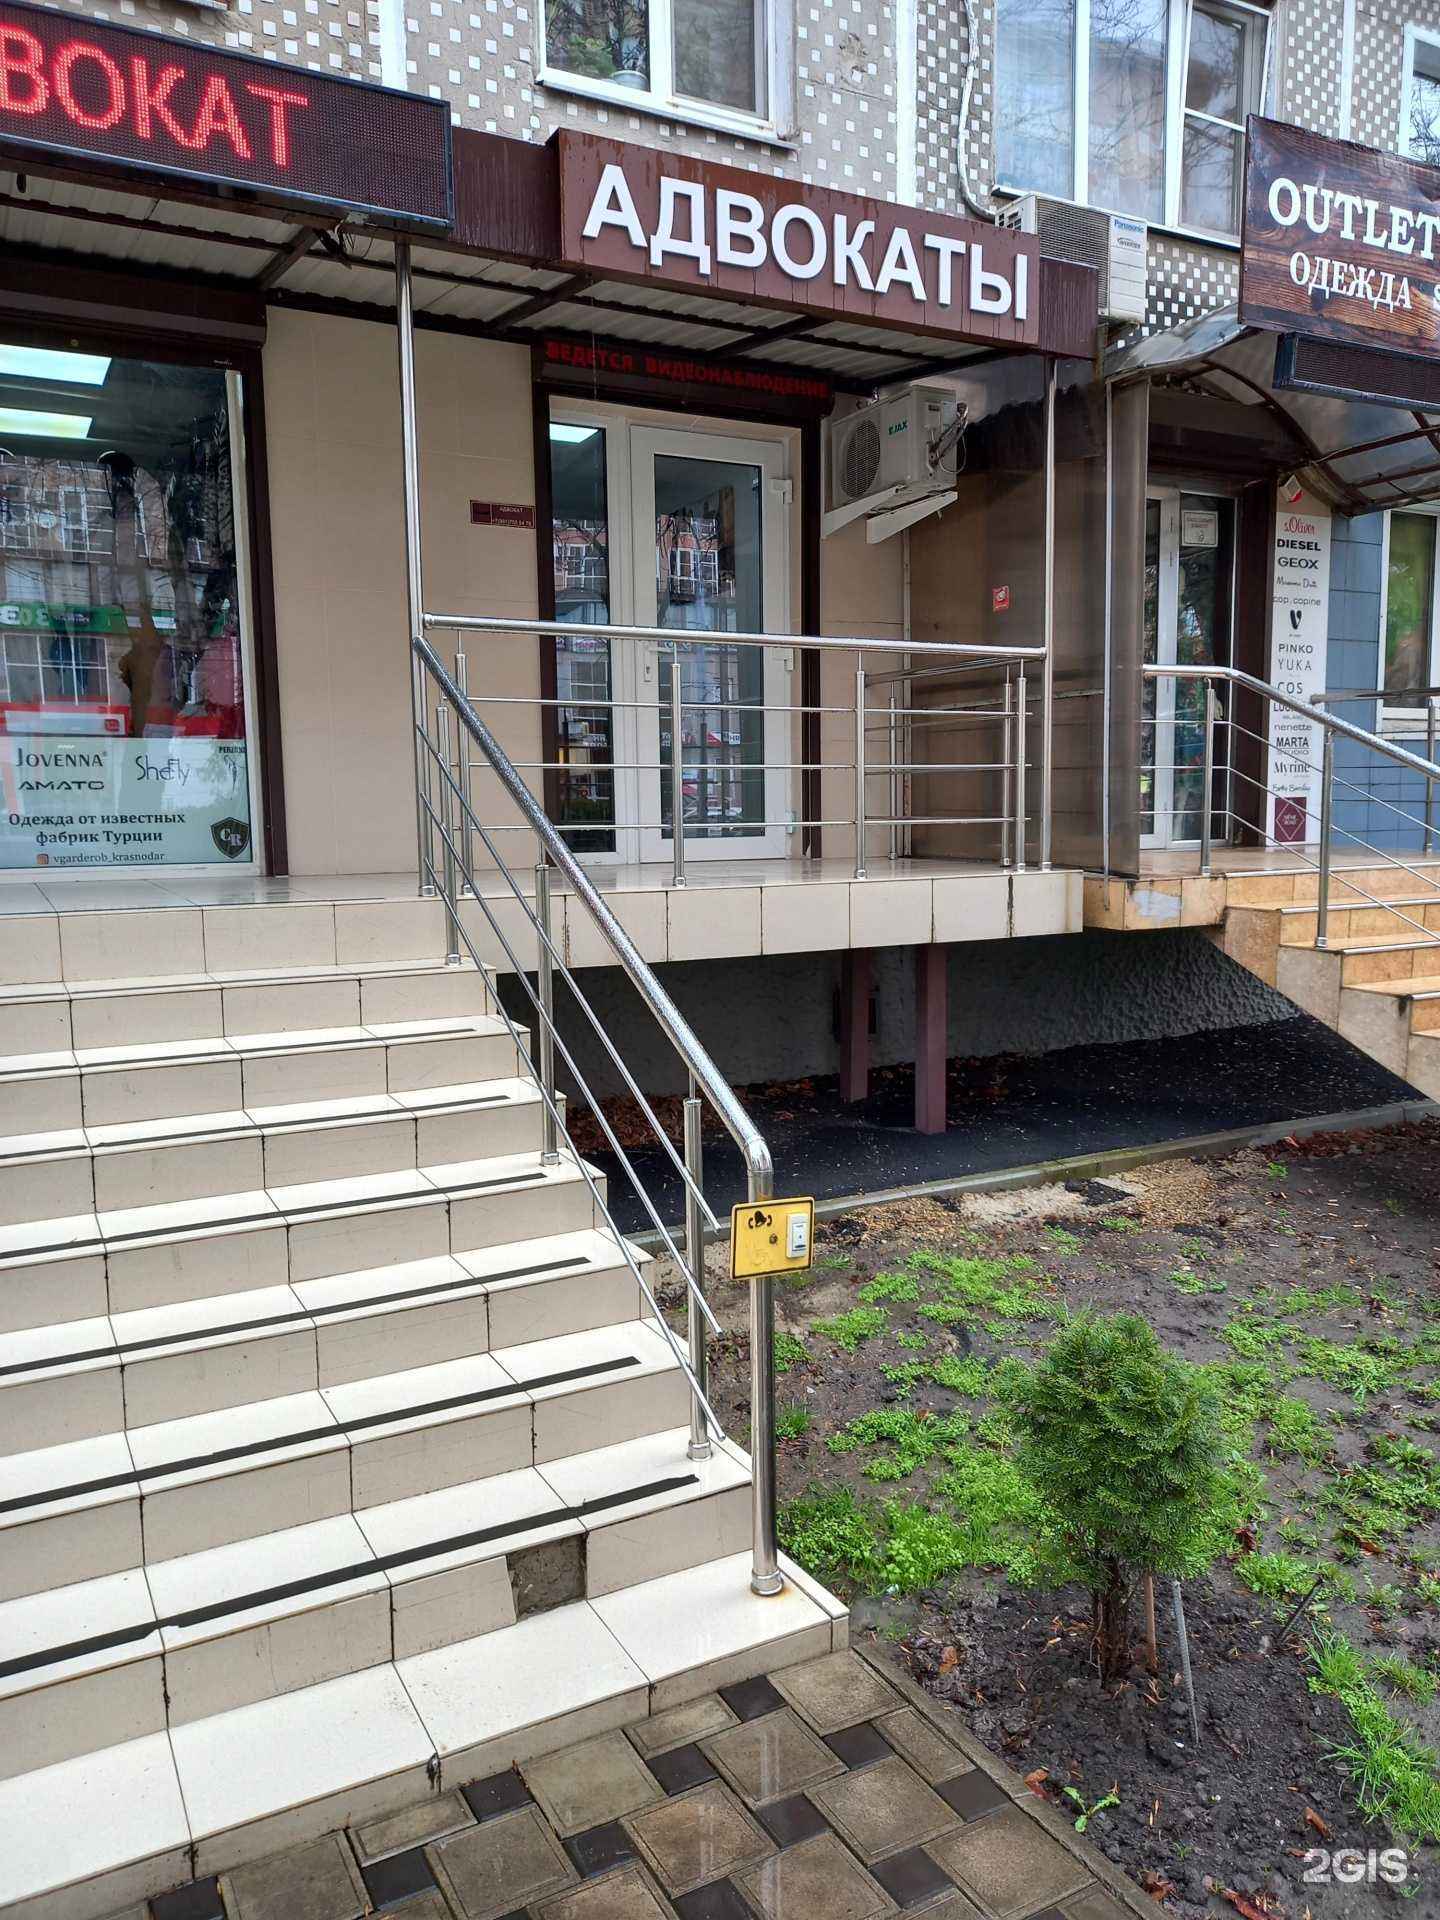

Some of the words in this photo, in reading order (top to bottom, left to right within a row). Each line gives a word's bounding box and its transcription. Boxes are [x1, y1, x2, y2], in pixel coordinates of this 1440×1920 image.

[0, 24, 308, 168] ВОКАТ
[1268, 177, 1440, 260] OUTLET
[583, 164, 1028, 319] АДВОКАТЫ
[1290, 252, 1412, 313] ОДЕЖДА
[1277, 539, 1321, 551] DIESEL
[1278, 557, 1319, 569] GEOX
[1279, 643, 1313, 654] PINKO
[1278, 659, 1312, 671] YUKA
[1276, 737, 1309, 748] MARTA
[16, 748, 104, 767] JOVENNA
[18, 781, 105, 790] AMATO
[9, 813, 74, 827] Одежда
[78, 815, 97, 825] от
[101, 813, 186, 825] известных
[36, 831, 99, 846] фабрик
[102, 830, 163, 845] Турции
[53, 851, 165, 865] vgarderob_krasnodar
